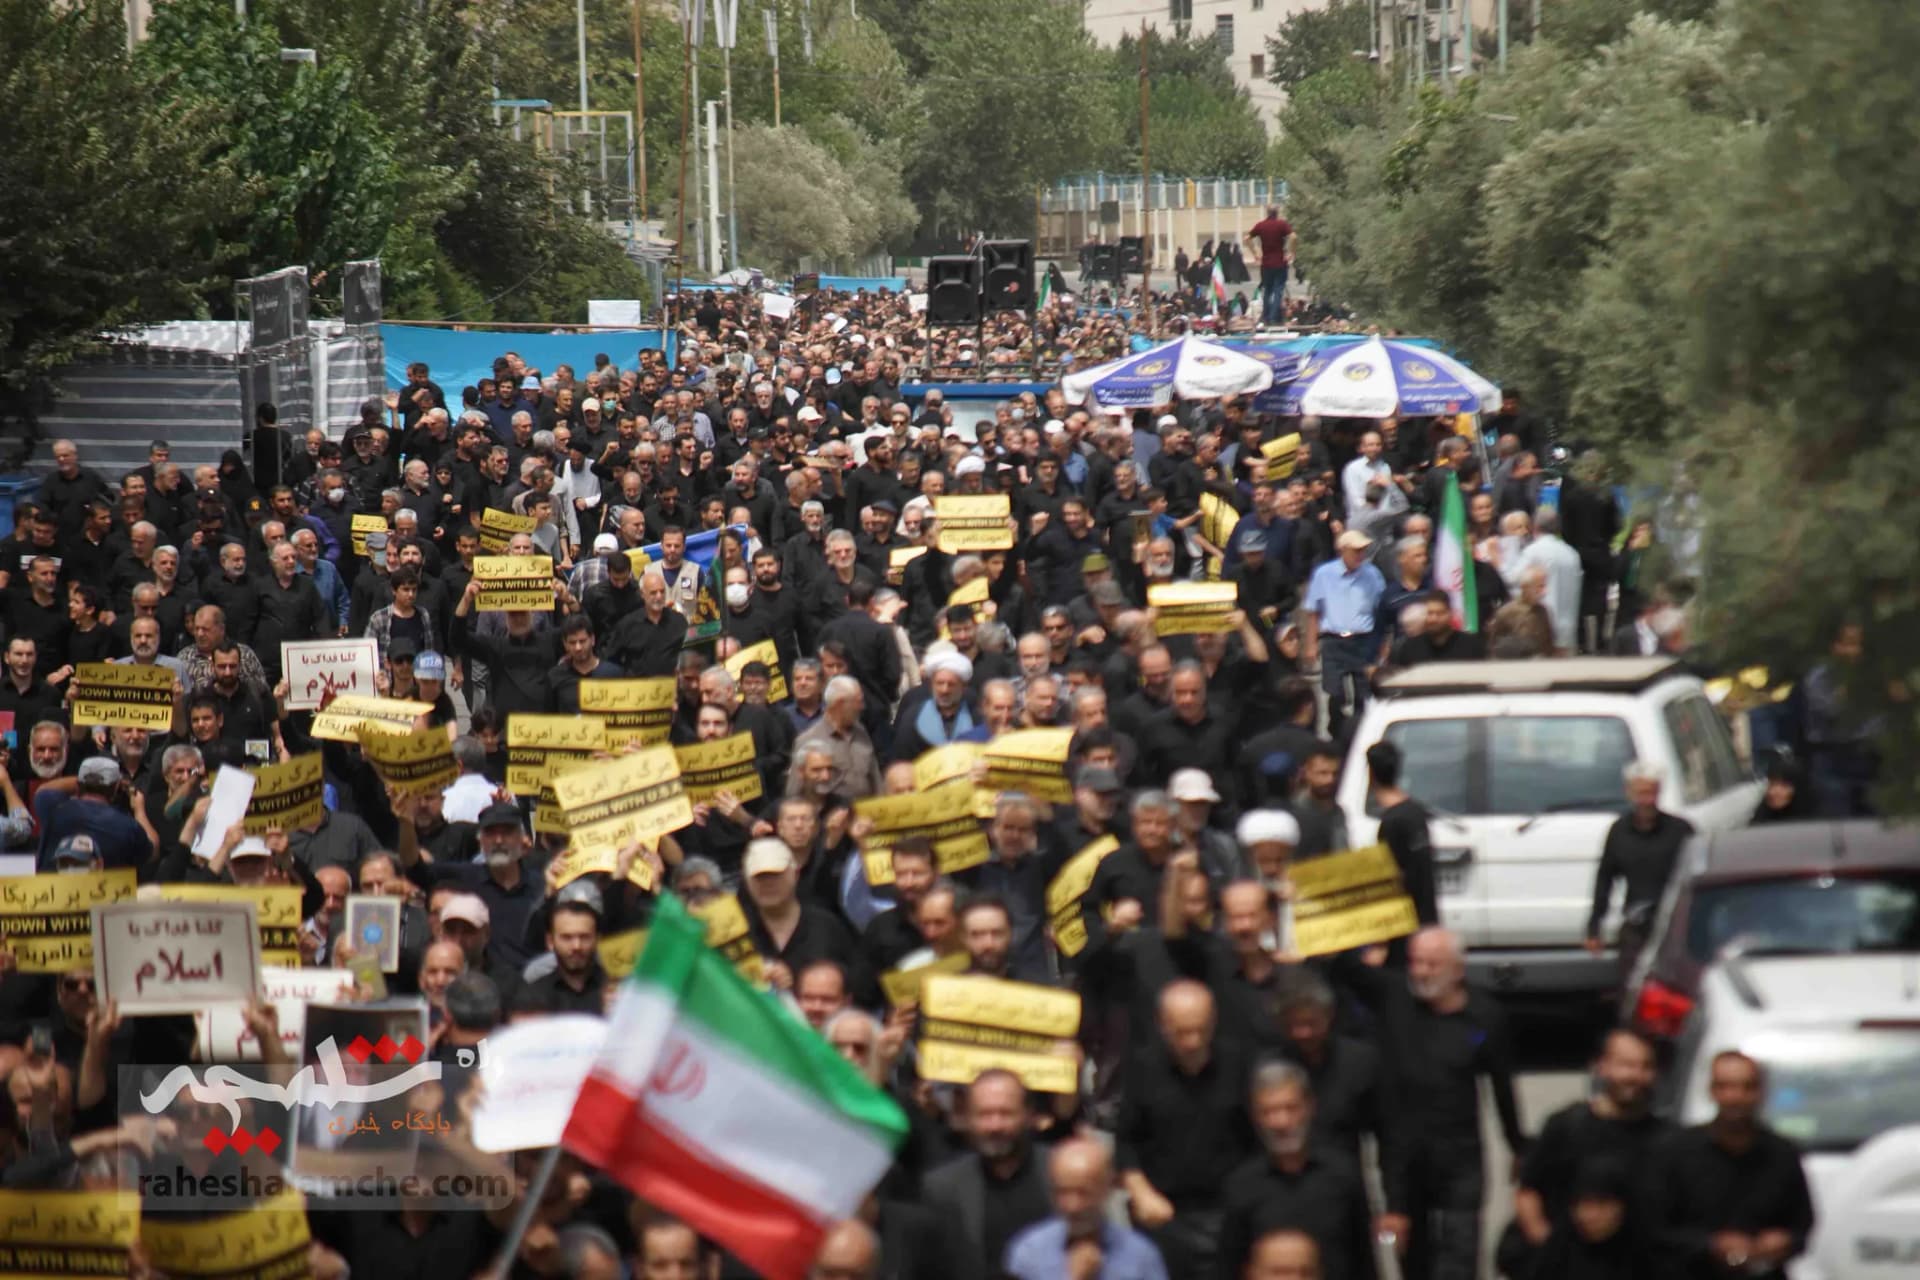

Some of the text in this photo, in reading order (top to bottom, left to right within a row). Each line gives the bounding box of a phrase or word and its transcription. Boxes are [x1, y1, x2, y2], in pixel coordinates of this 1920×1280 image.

[527, 560, 551, 574] مرگ
[481, 580, 504, 590] OWN
[505, 579, 528, 589] WITH
[520, 594, 552, 607] الموت
[126, 674, 135, 685] بر
[142, 671, 171, 685] مرگ
[306, 671, 356, 698] اسلام
[112, 690, 141, 700] WITH
[129, 709, 168, 724] الموت
[510, 750, 544, 762] DOWN
[258, 794, 290, 812] WITH
[568, 802, 610, 826] DOWN
[610, 794, 645, 815] WITH
[67, 890, 80, 908] بر
[89, 879, 131, 904] مرگ
[1, 915, 91, 934] DOWN WITH
[134, 947, 223, 996] اسلام
[15, 1251, 64, 1270] WITH
